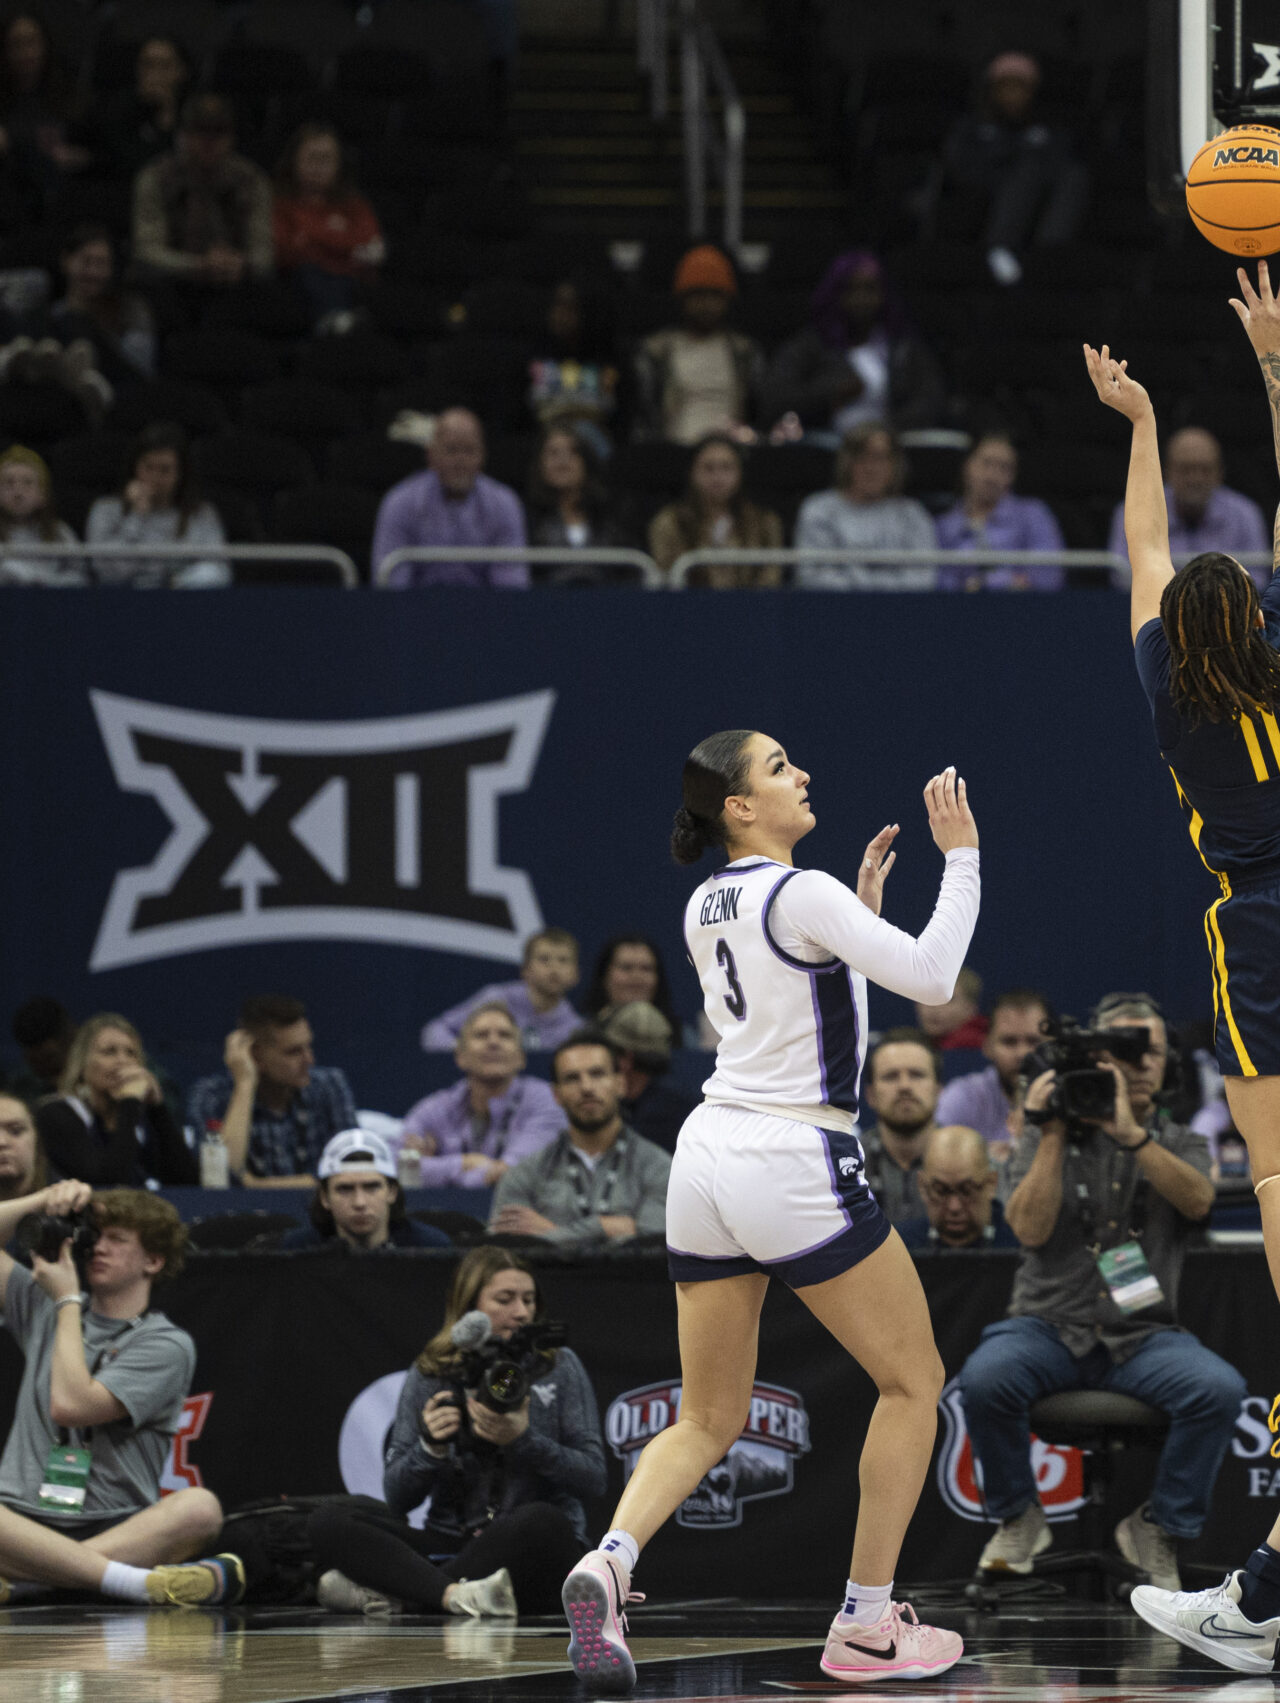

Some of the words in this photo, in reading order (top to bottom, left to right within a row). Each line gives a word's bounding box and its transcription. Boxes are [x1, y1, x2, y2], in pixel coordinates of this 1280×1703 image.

[1212, 146, 1280, 169] NCAA
[700, 886, 743, 927] GLENN
[715, 937, 747, 1021] 3
[608, 1399, 669, 1445] OLD
